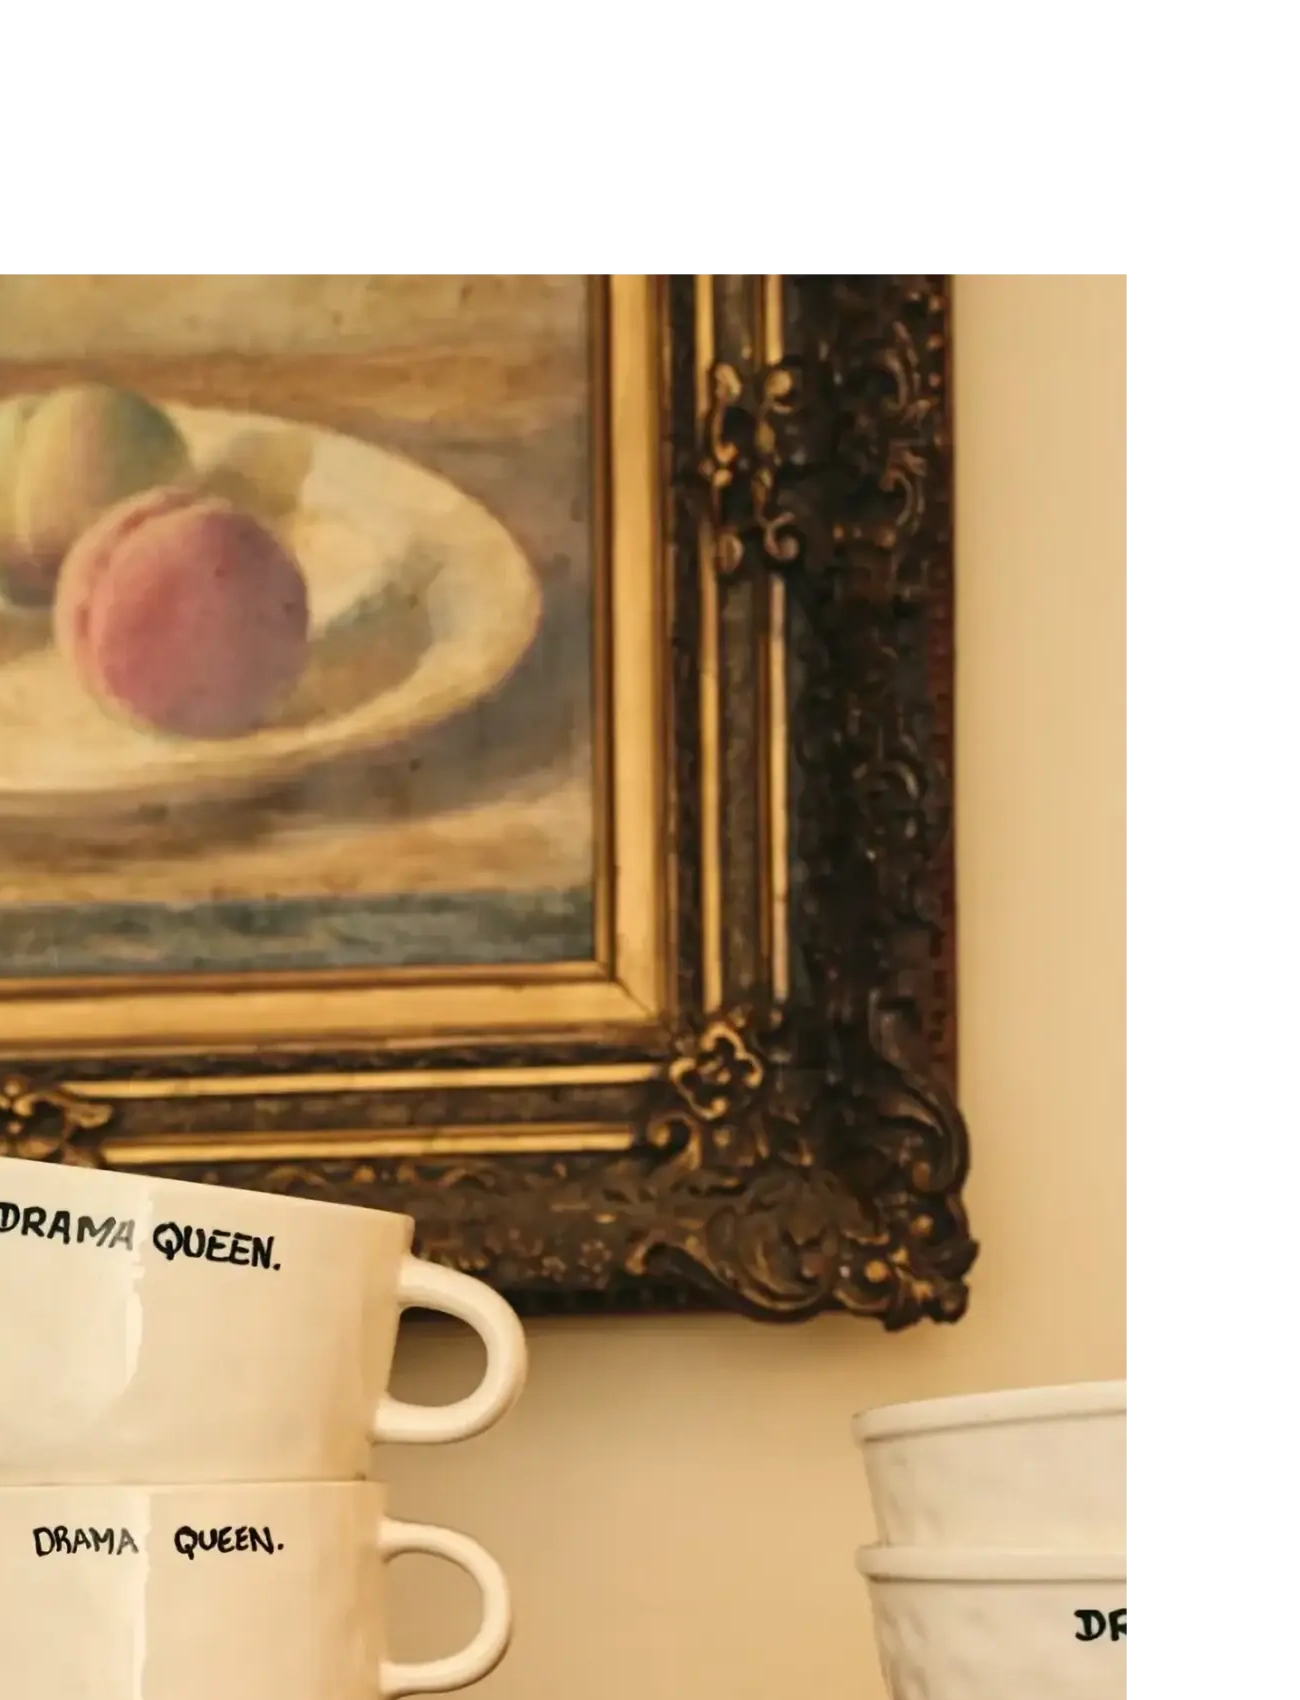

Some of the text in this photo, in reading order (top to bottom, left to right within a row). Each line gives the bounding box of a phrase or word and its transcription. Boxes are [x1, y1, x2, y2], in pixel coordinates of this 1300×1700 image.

[152, 1221, 282, 1271] QUEEN.
[33, 1525, 285, 1561] DRAMA QUEEN.
